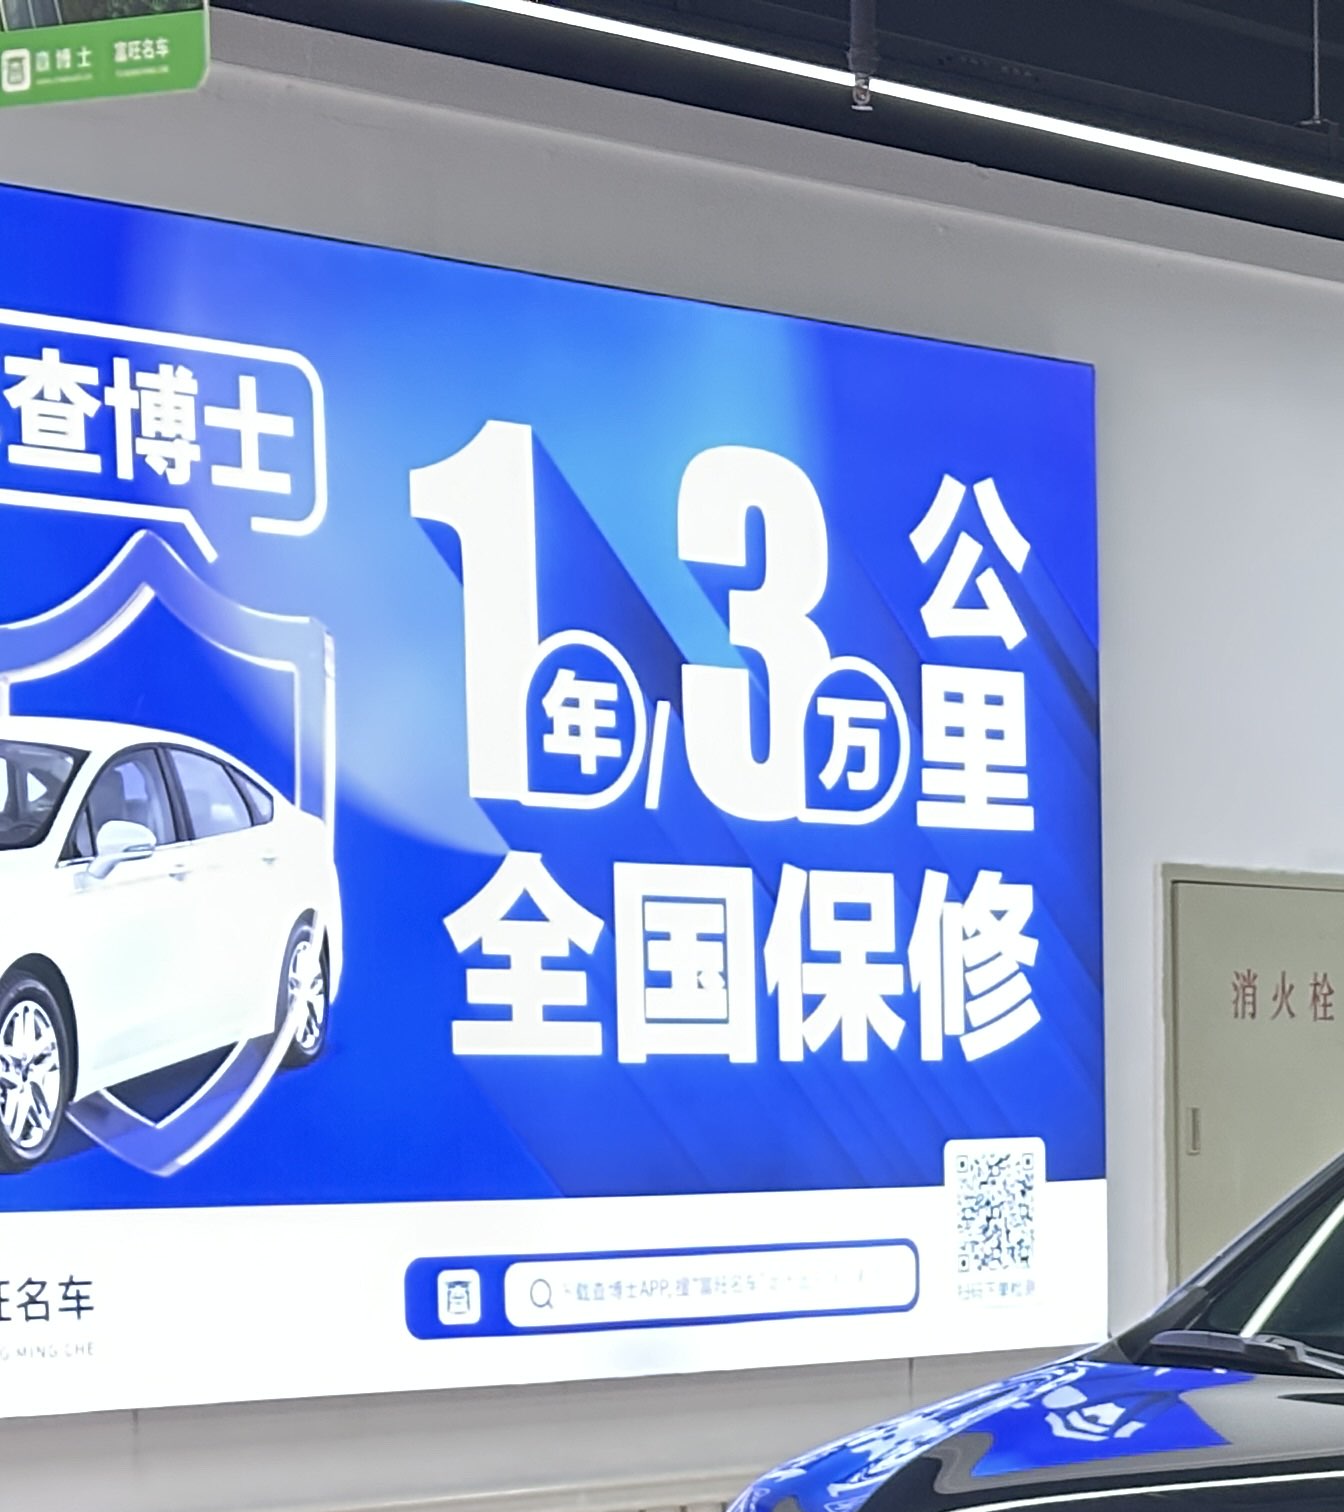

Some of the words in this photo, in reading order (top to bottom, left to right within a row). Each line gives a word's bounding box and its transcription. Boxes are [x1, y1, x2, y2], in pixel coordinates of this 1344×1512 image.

[3, 347, 294, 495] 查博士
[442, 850, 1042, 1064] 全国保修
[1231, 968, 1336, 1022] 消火栓
